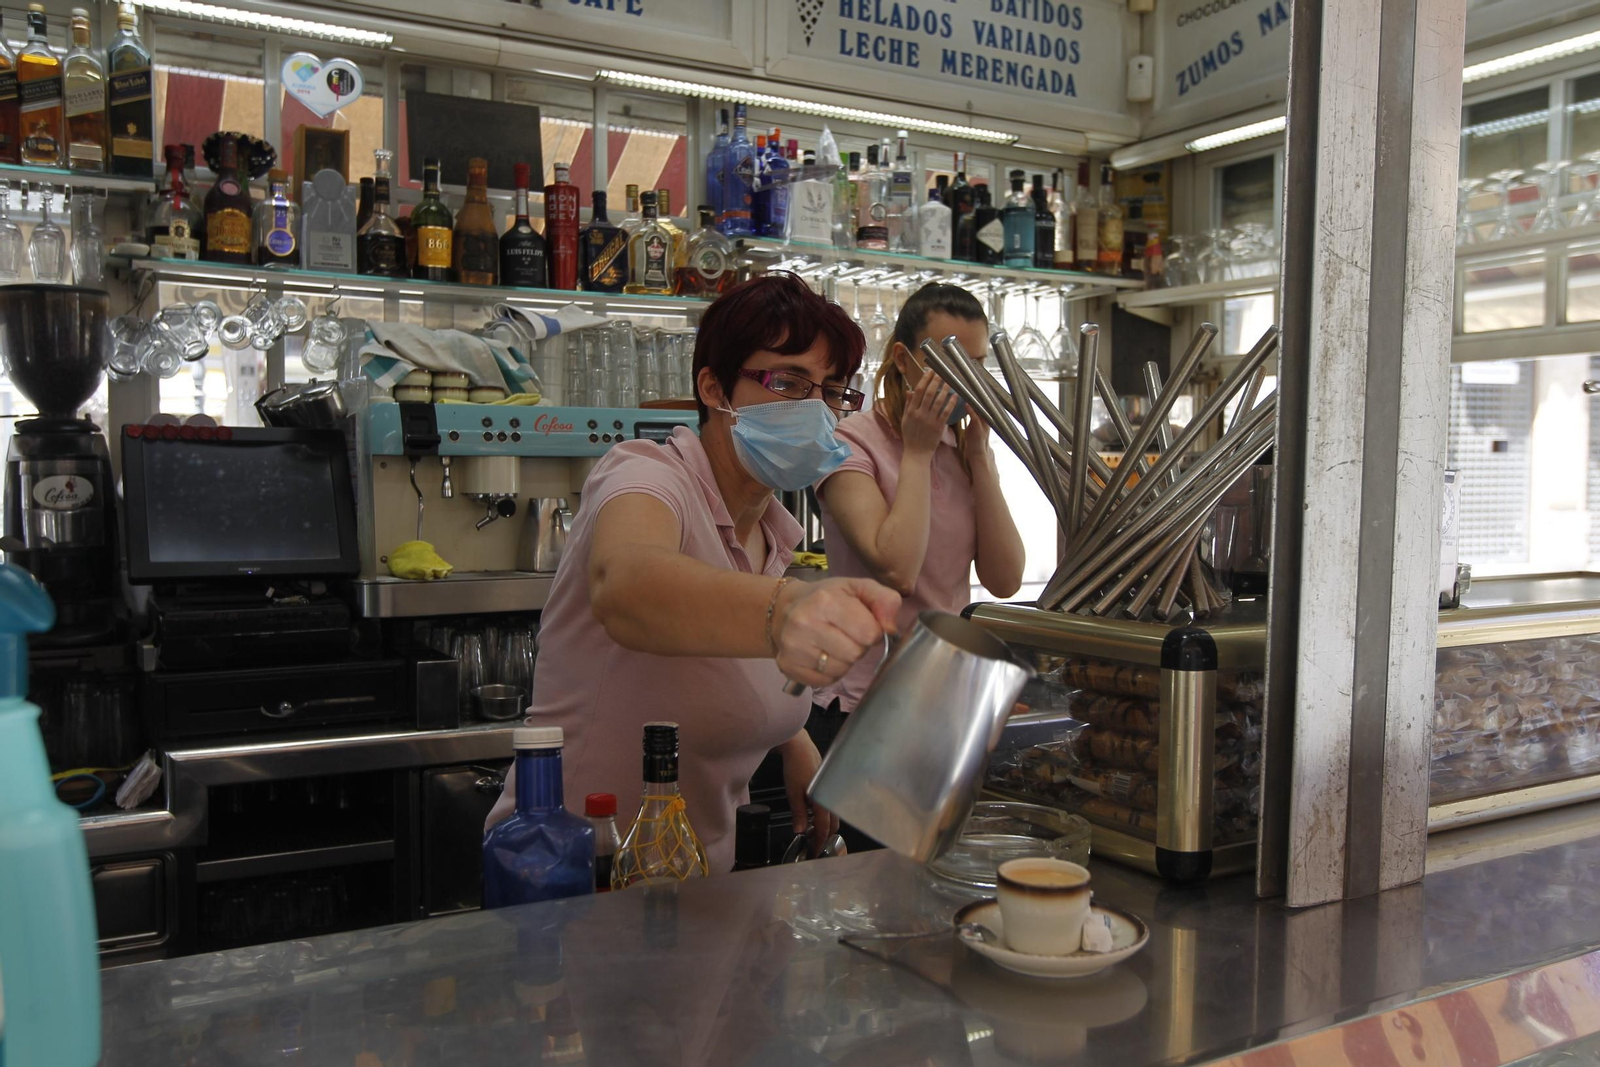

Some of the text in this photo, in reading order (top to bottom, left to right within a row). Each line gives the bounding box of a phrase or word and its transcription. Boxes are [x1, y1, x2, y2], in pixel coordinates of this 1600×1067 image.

[839, 0, 1080, 65] HELADOS VARIADOS
[1177, 0, 1290, 96] ZUMOS NA
[839, 28, 1077, 97] LECHE MERENGADA
[549, 194, 576, 202] RON
[549, 203, 577, 211] DEL
[549, 212, 577, 221] REY
[592, 231, 625, 278] BRUGAL
